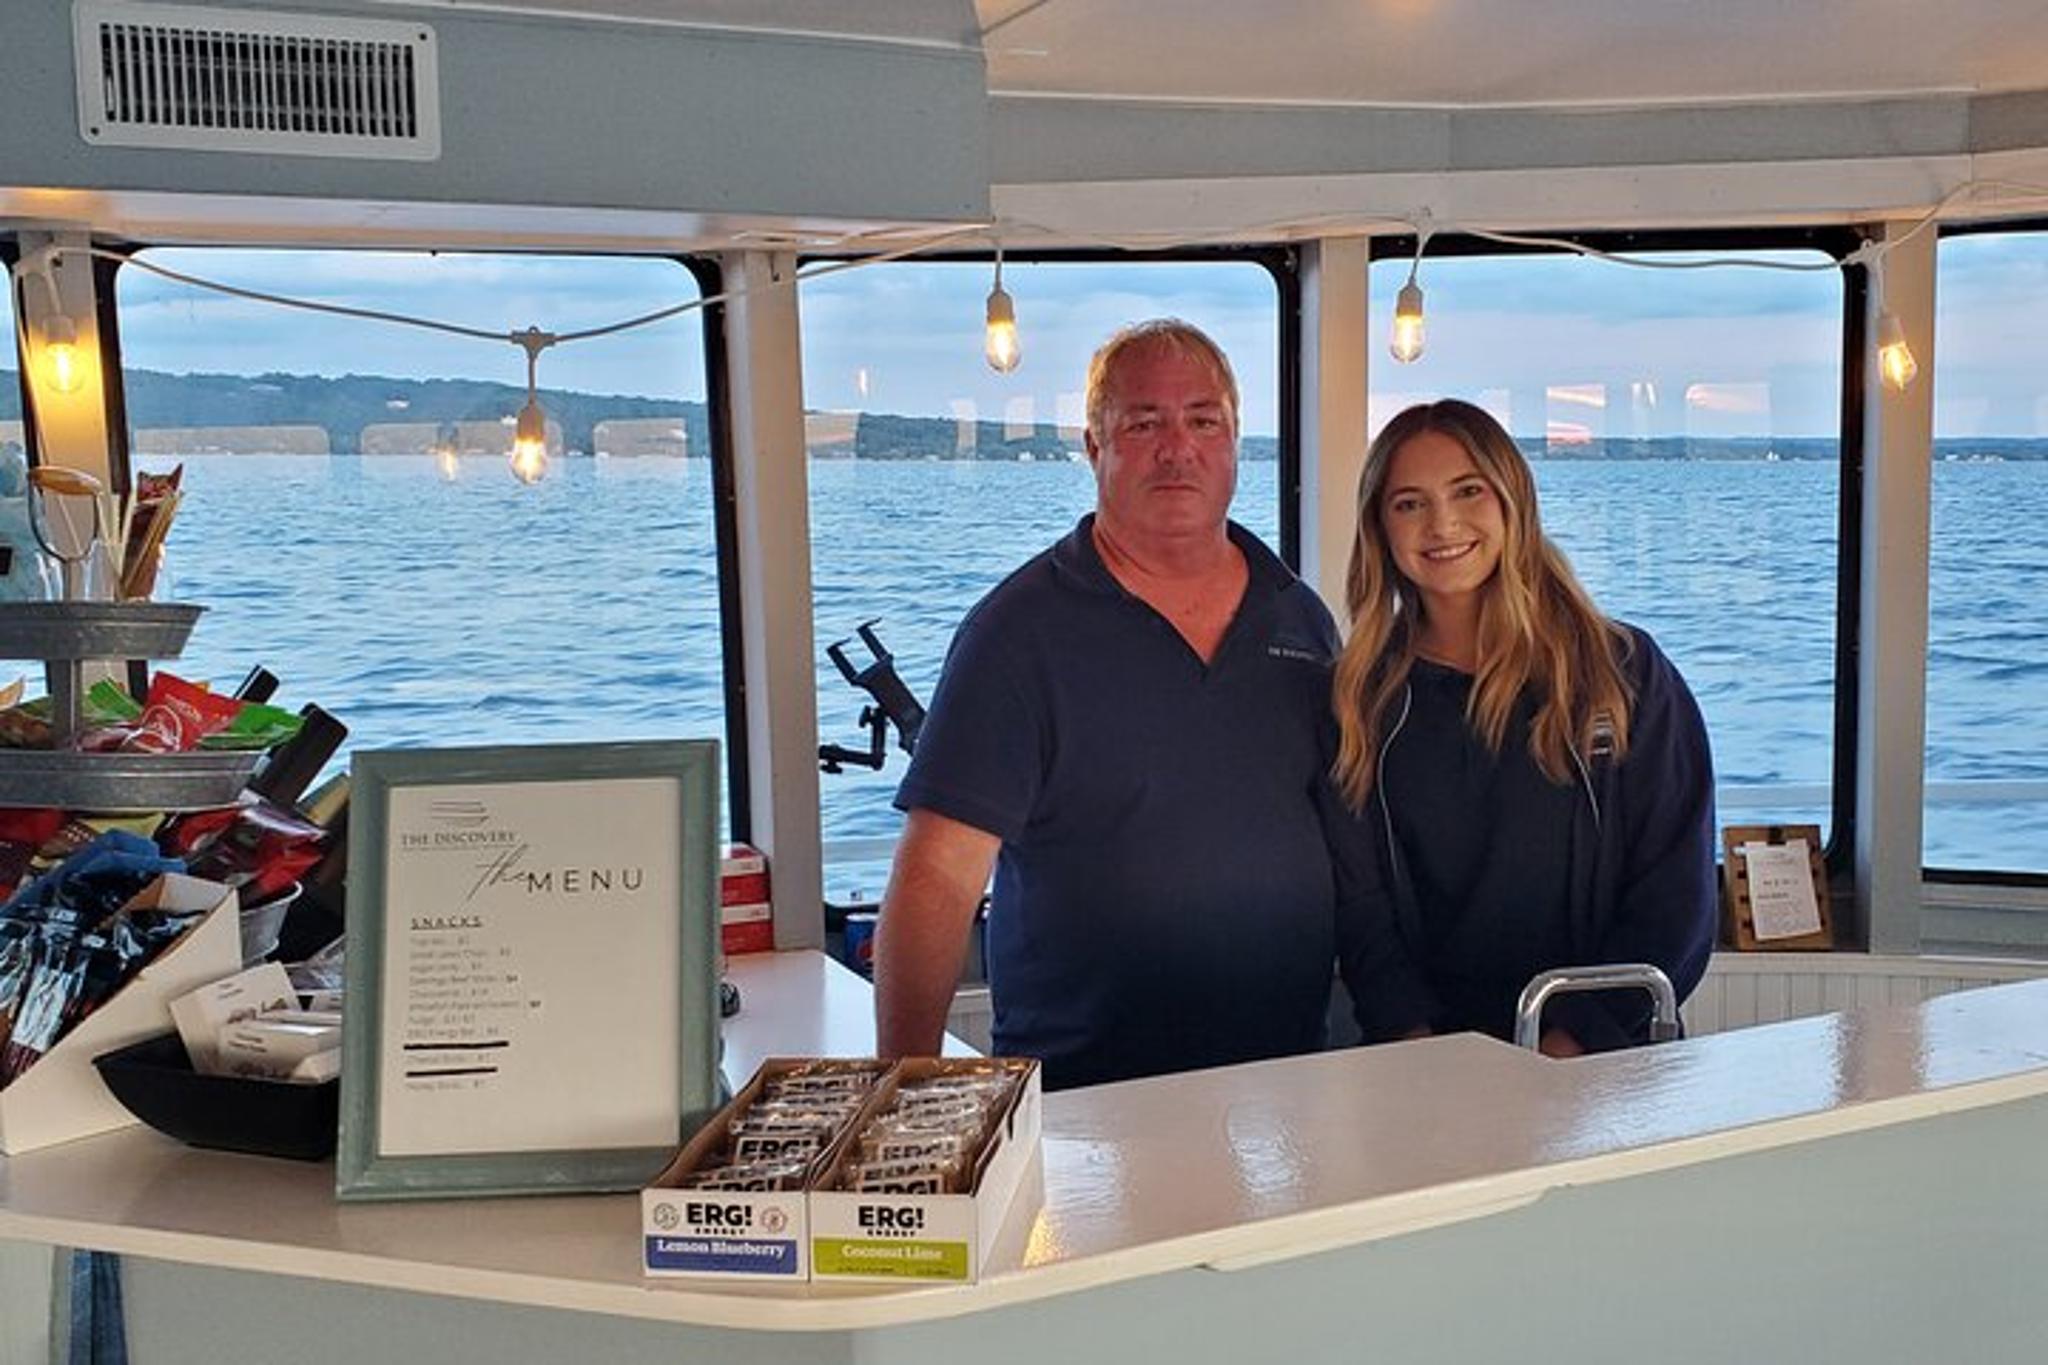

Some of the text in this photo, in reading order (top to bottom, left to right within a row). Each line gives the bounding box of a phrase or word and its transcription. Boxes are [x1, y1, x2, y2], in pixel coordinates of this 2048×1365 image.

[401, 830, 516, 846] THE DISCOVERY
[527, 869, 643, 893] MENU
[410, 916, 482, 929] SNACKS
[686, 1202, 753, 1226] ERG!
[858, 1205, 925, 1229] ERG!
[656, 1238, 786, 1260] Lemon Blueberry
[841, 1243, 943, 1261] Coconut Lime
